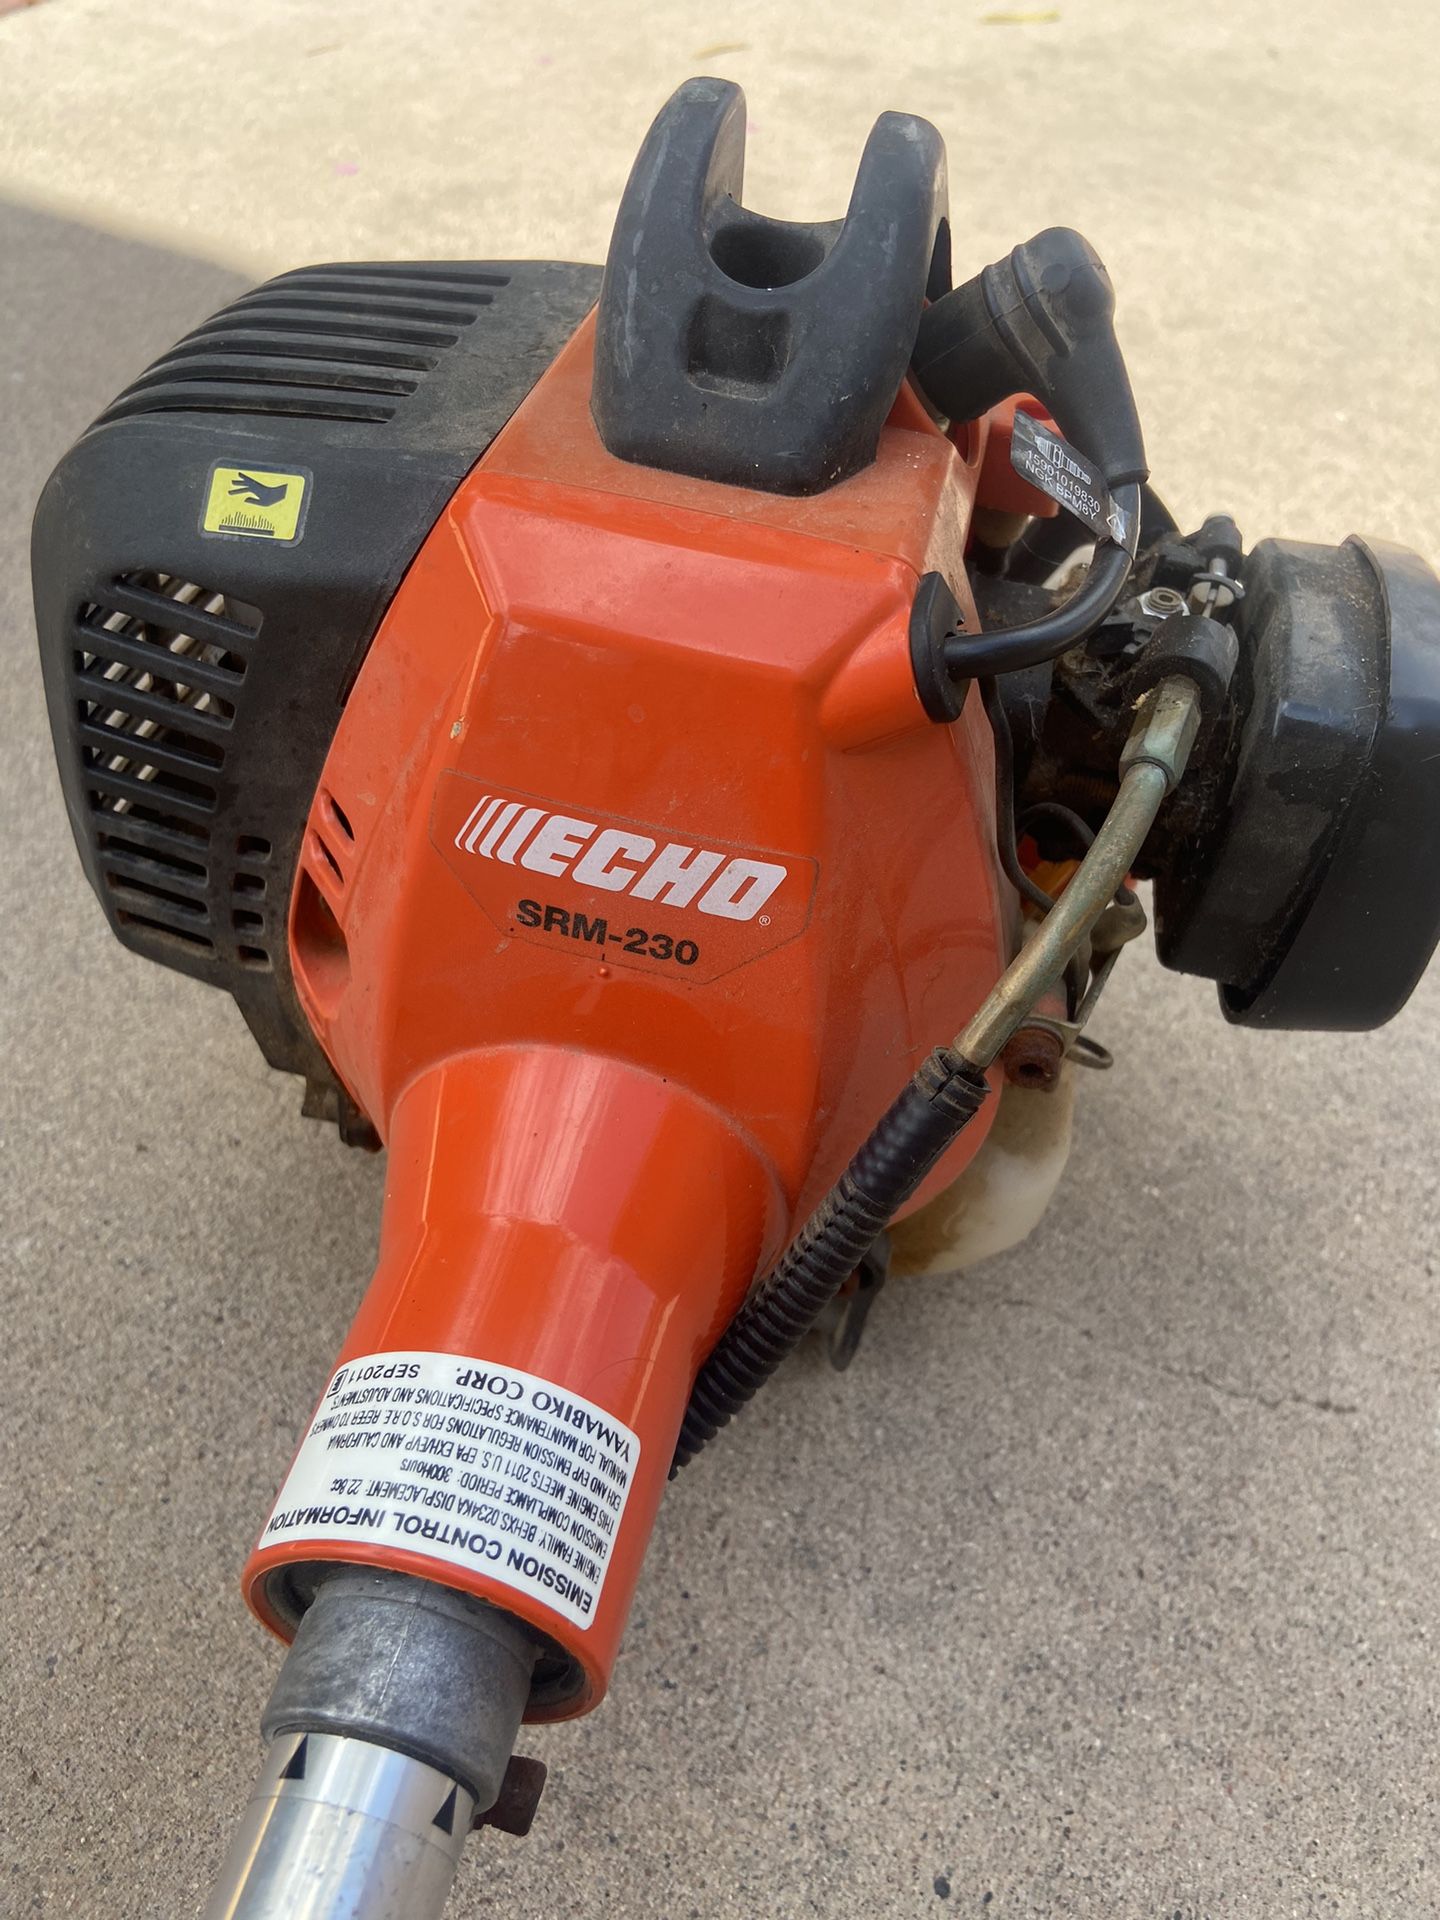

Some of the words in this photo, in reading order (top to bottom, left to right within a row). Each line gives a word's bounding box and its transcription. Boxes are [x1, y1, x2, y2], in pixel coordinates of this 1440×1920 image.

[1025, 460, 1055, 487] NGK
[1026, 450, 1101, 512] 15901019830
[520, 814, 788, 922] ECHO
[516, 899, 700, 966] SRM-230
[392, 1387, 416, 1402] AND
[456, 1367, 523, 1399] CORP.
[350, 1410, 381, 1425] REFER
[414, 1388, 503, 1420] SPECIFICATIONS
[338, 1411, 351, 1427] TO
[422, 1412, 446, 1430] FOR
[503, 1407, 578, 1453] MAINTENANCE
[531, 1391, 628, 1463] YAMABIKO
[326, 1431, 380, 1450] CALIFORNIA
[380, 1432, 406, 1448] AND
[445, 1417, 522, 1452] REGULATIONS
[456, 1443, 478, 1464] EPA
[482, 1450, 500, 1472] U.S.
[522, 1440, 572, 1476] EMISSION
[578, 1440, 597, 1464] FOR
[399, 1457, 453, 1482] 300Hours
[504, 1459, 531, 1483] 2011
[571, 1466, 590, 1487] EVP
[598, 1452, 627, 1488] MANUAL
[365, 1479, 456, 1511] DISPLACEMENT:
[456, 1470, 504, 1499] PERIOD:
[530, 1470, 566, 1500] MEETS
[590, 1476, 607, 1498] AND
[503, 1486, 568, 1531] COMPLIANCE
[564, 1488, 599, 1521] ENGINE
[606, 1488, 622, 1511] EXH
[265, 1506, 386, 1534] INFORMATION
[596, 1508, 613, 1535] THIS
[392, 1512, 501, 1559] CONTROL
[569, 1519, 608, 1559] EMISSION
[505, 1547, 593, 1614] EMISSION
[571, 1550, 601, 1584] ENGINE
